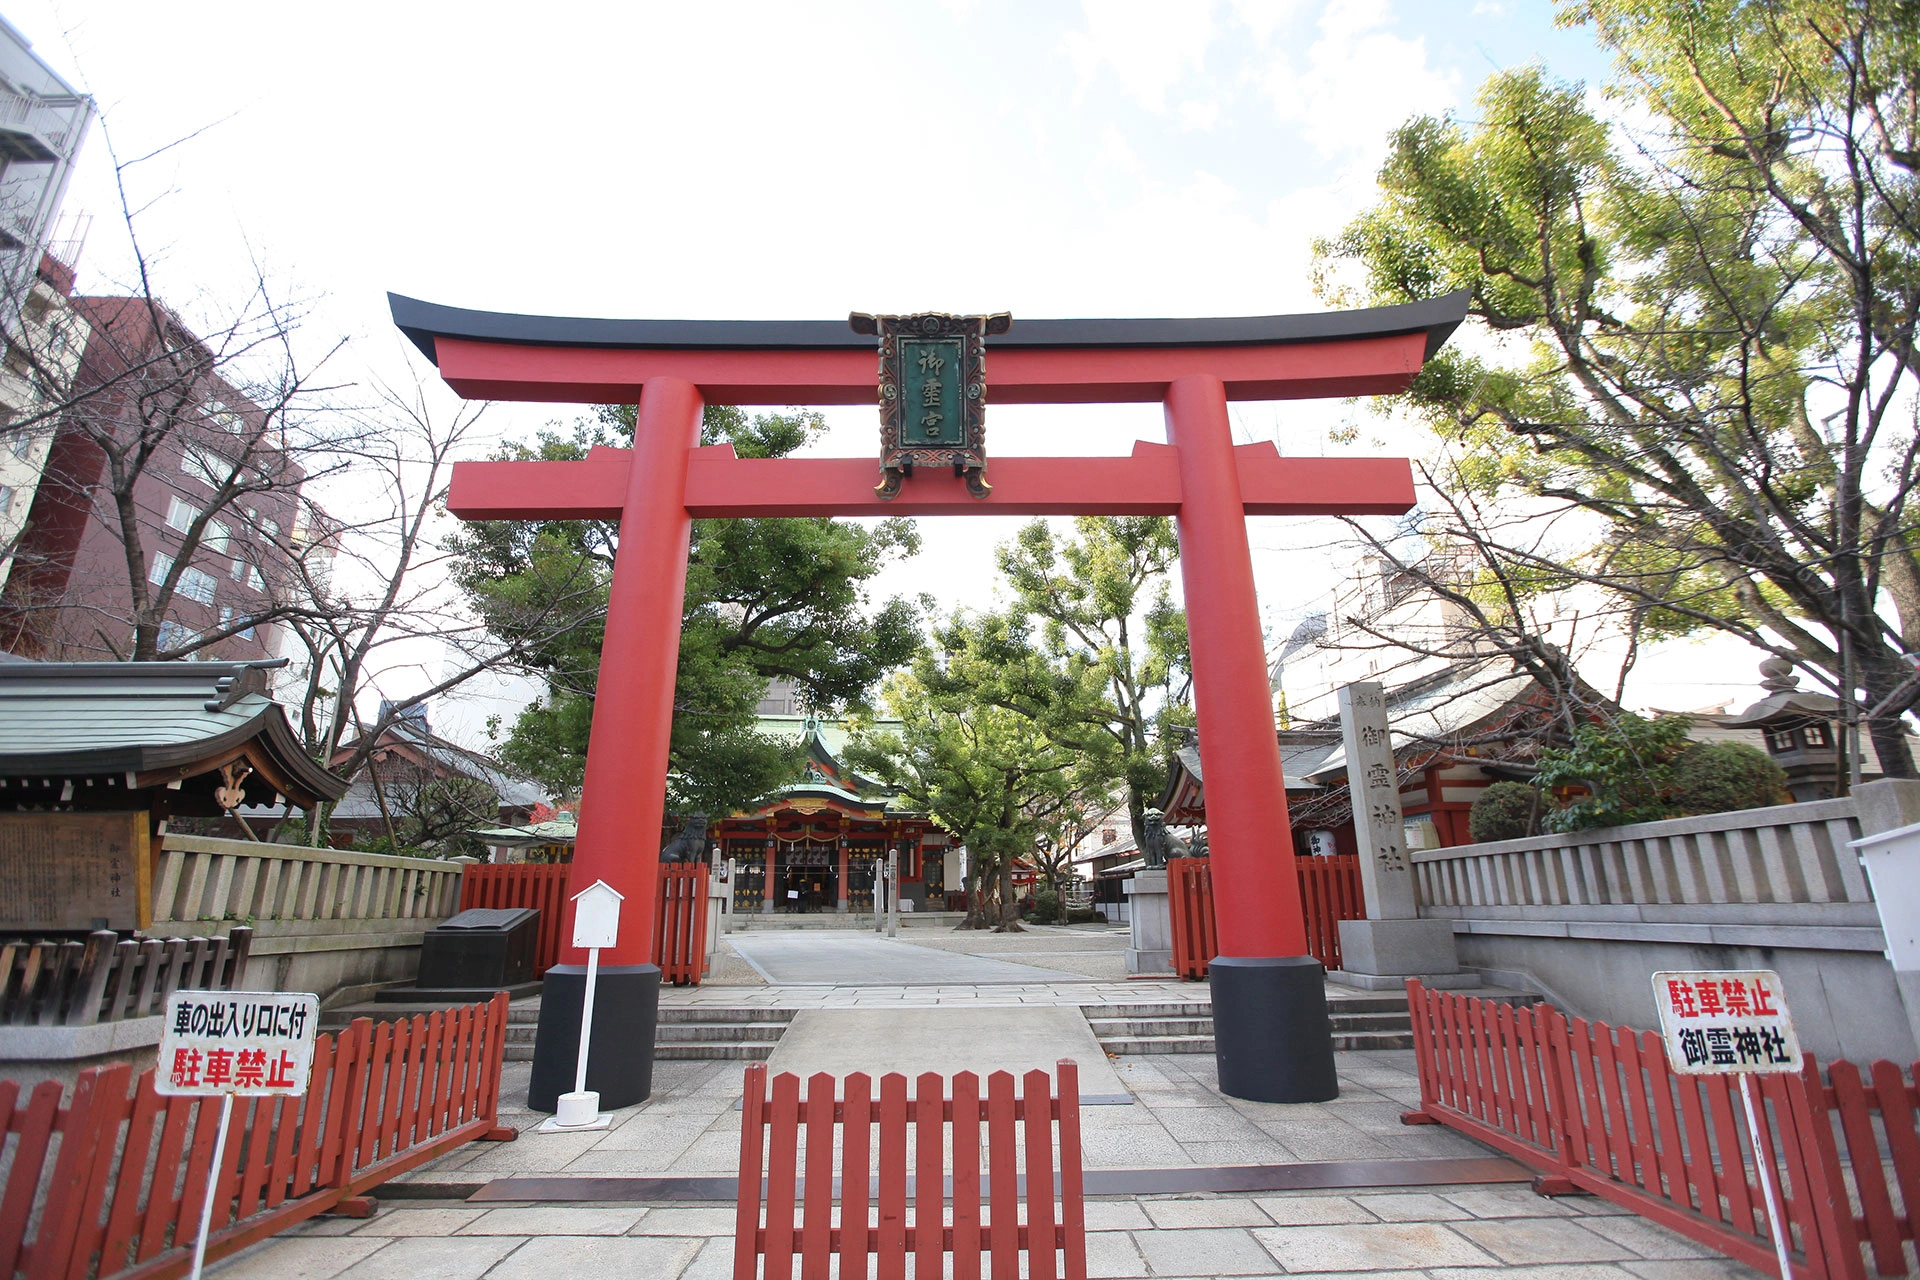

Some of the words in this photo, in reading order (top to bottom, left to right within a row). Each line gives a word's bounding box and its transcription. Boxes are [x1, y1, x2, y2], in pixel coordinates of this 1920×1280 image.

[1362, 725, 1405, 872] 御霊神社
[1311, 834, 1321, 856] 御神
[1666, 979, 1778, 1018] 駐車禁止
[173, 1001, 307, 1039] 車の出入り口に付
[1678, 1026, 1791, 1066] 御霊神社
[170, 1048, 295, 1088] 駐車禁止
